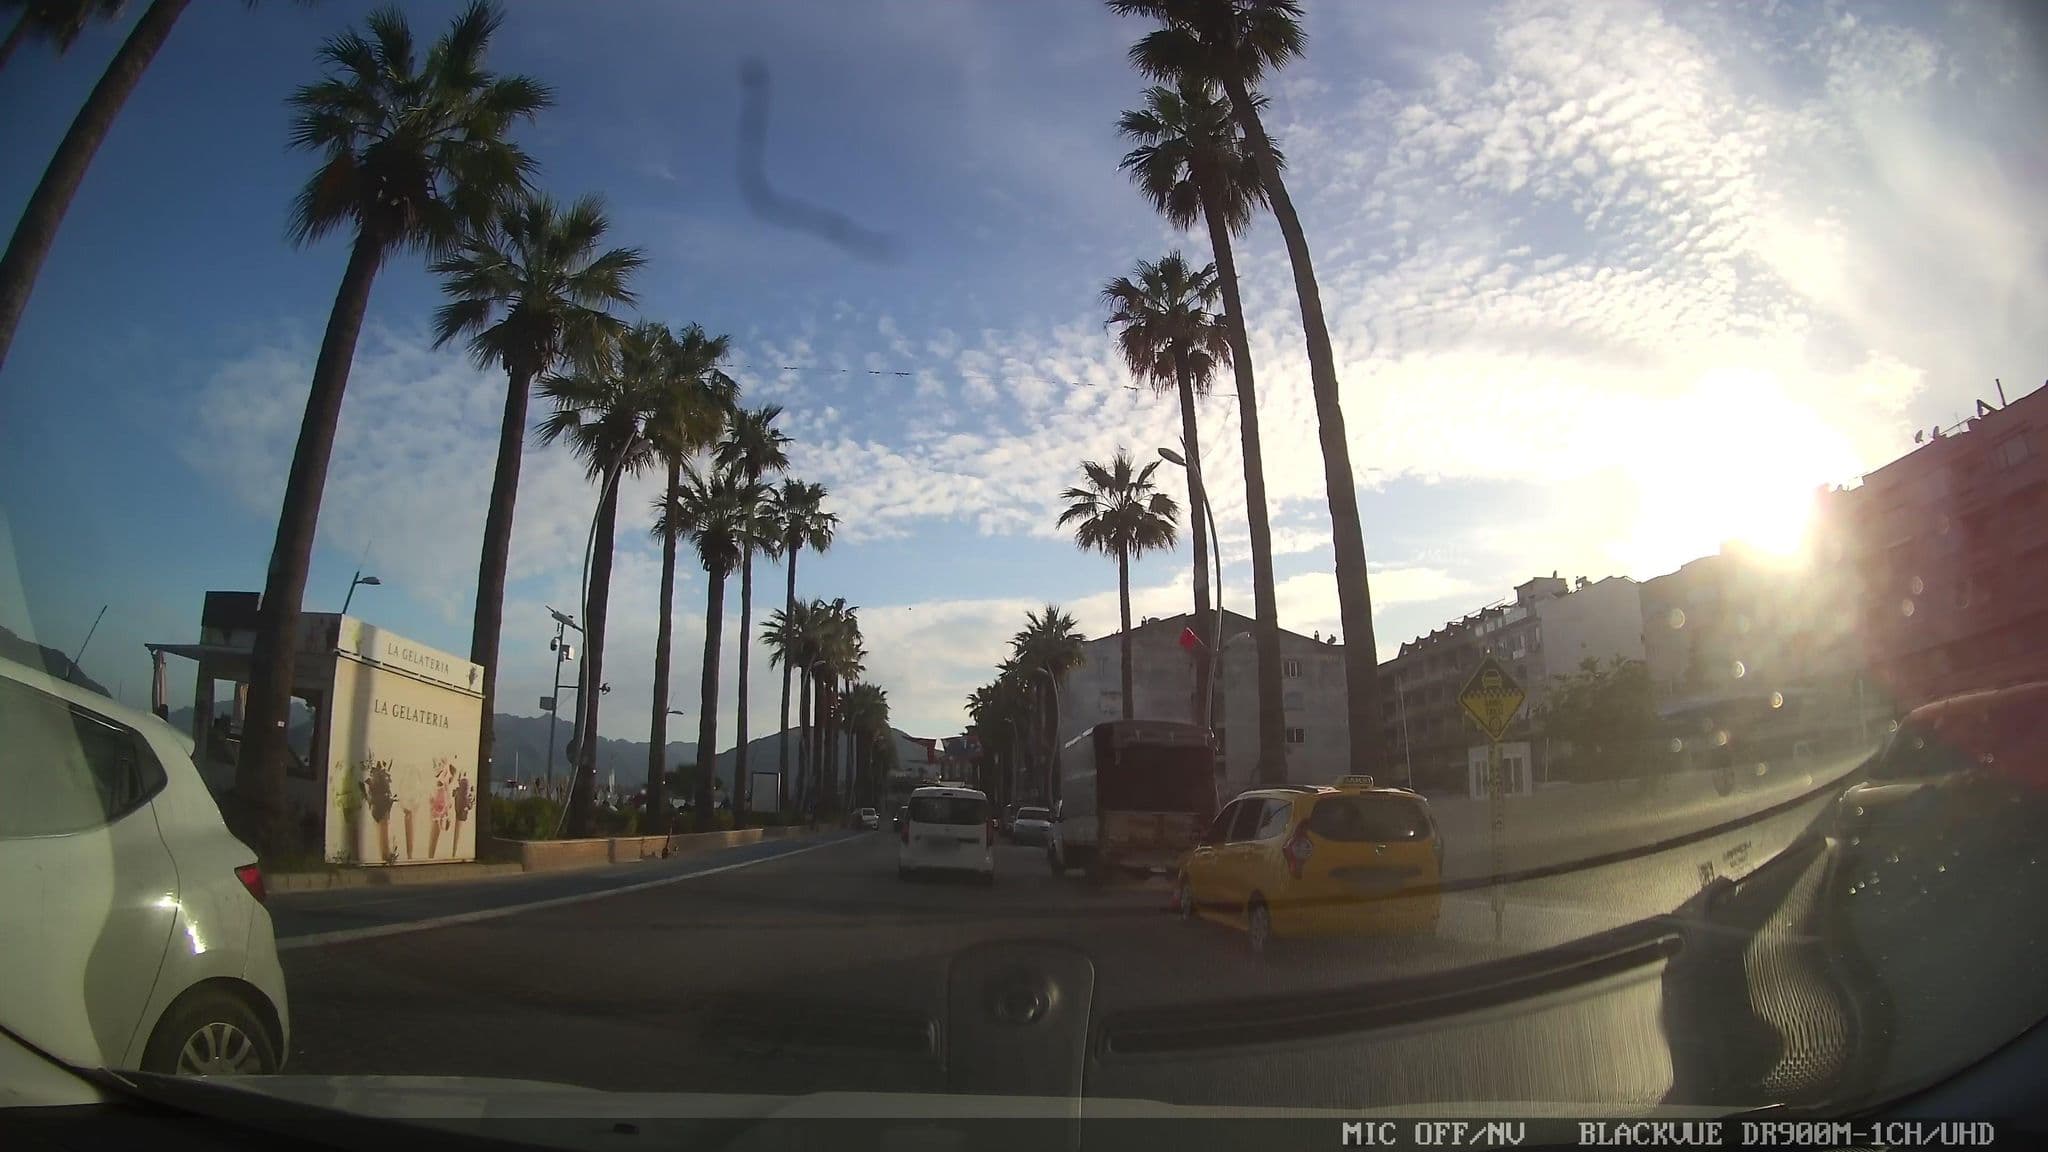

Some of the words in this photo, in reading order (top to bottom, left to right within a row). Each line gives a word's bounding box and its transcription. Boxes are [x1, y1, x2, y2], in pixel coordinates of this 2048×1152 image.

[387, 643, 399, 657] LA
[402, 649, 449, 674] GELATERIA
[374, 699, 388, 715] LA
[392, 704, 449, 728] GELATERIA
